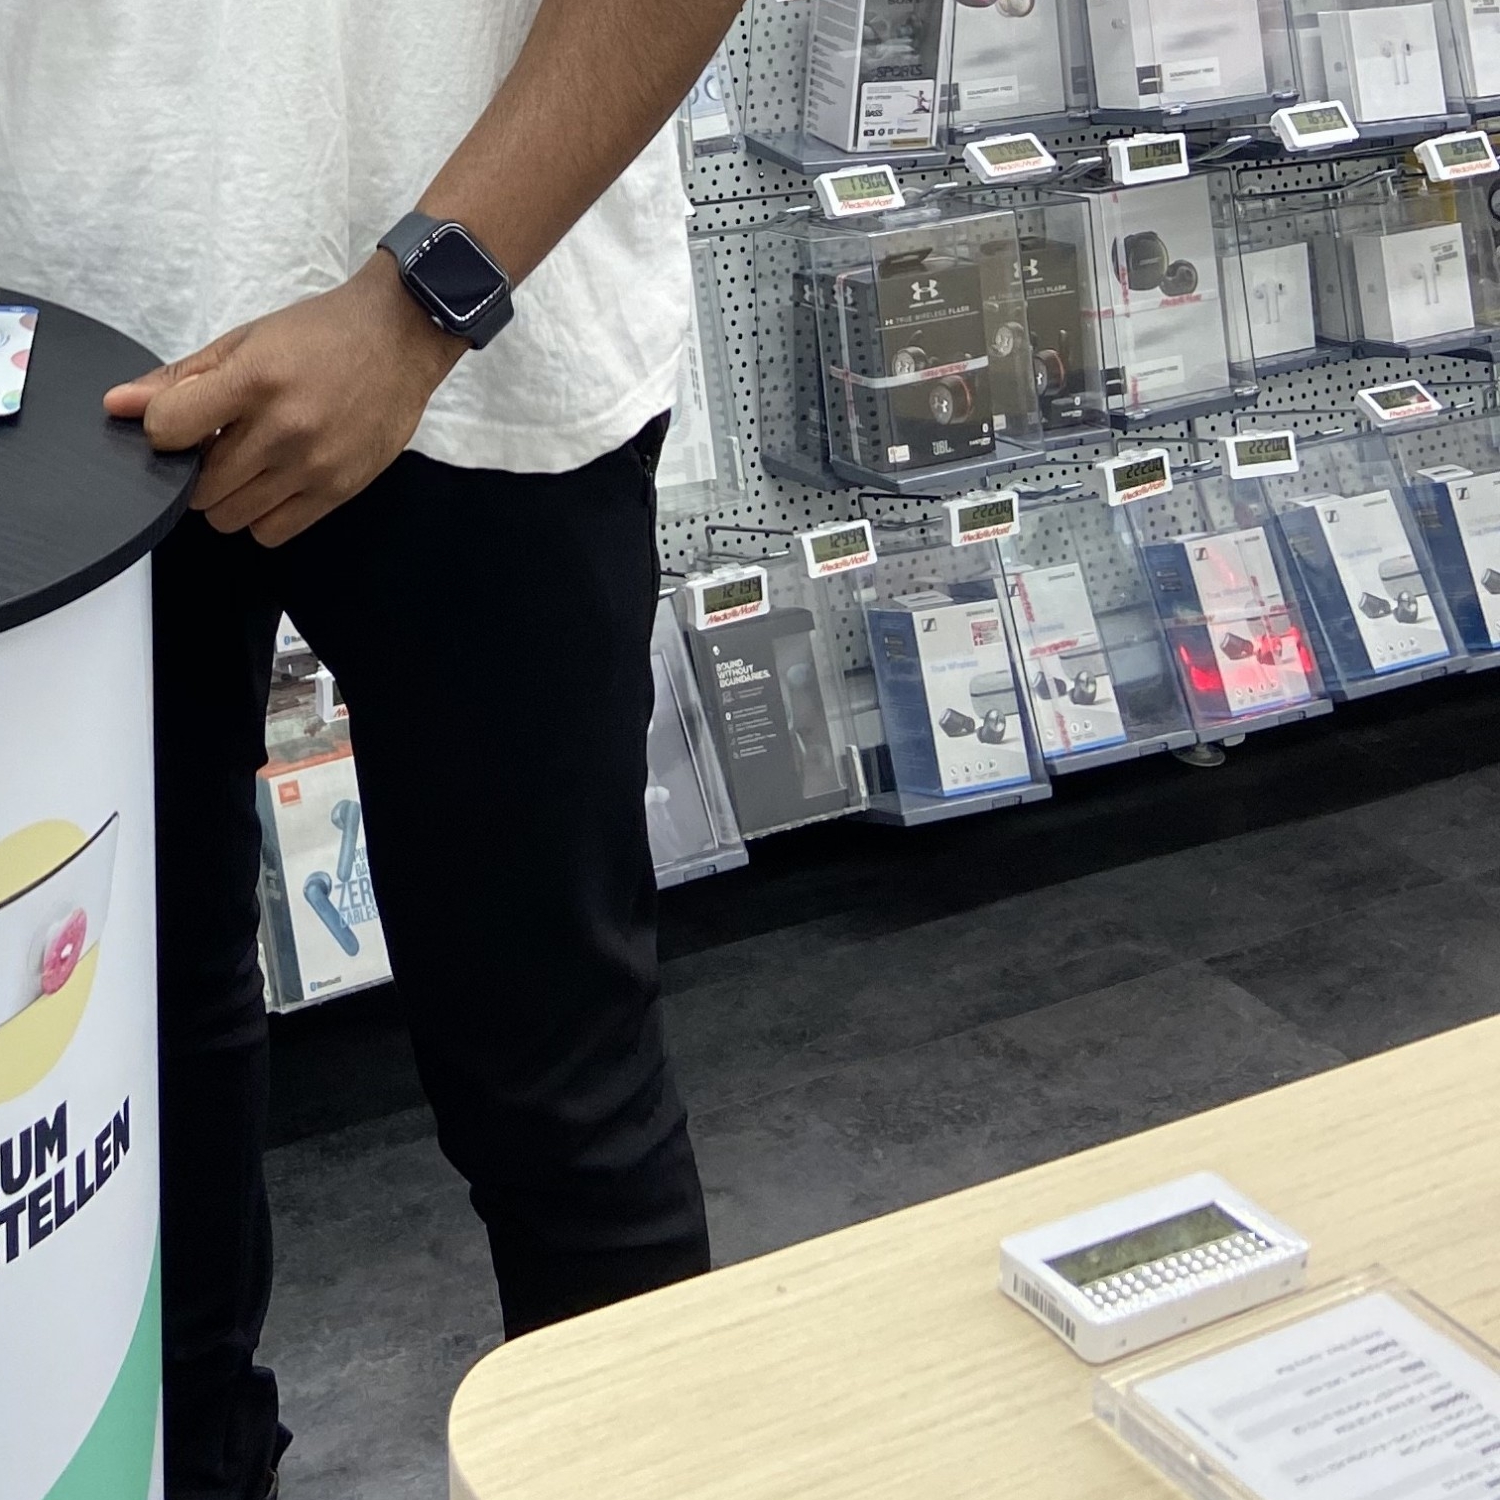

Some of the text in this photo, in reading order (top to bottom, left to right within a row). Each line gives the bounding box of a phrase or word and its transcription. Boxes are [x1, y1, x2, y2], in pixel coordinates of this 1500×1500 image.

[876, 64, 923, 77] SPORTS
[932, 441, 952, 455] JBL
[716, 658, 744, 672] SOUND
[717, 664, 754, 679] WITHOUT
[334, 877, 374, 912] ZER
